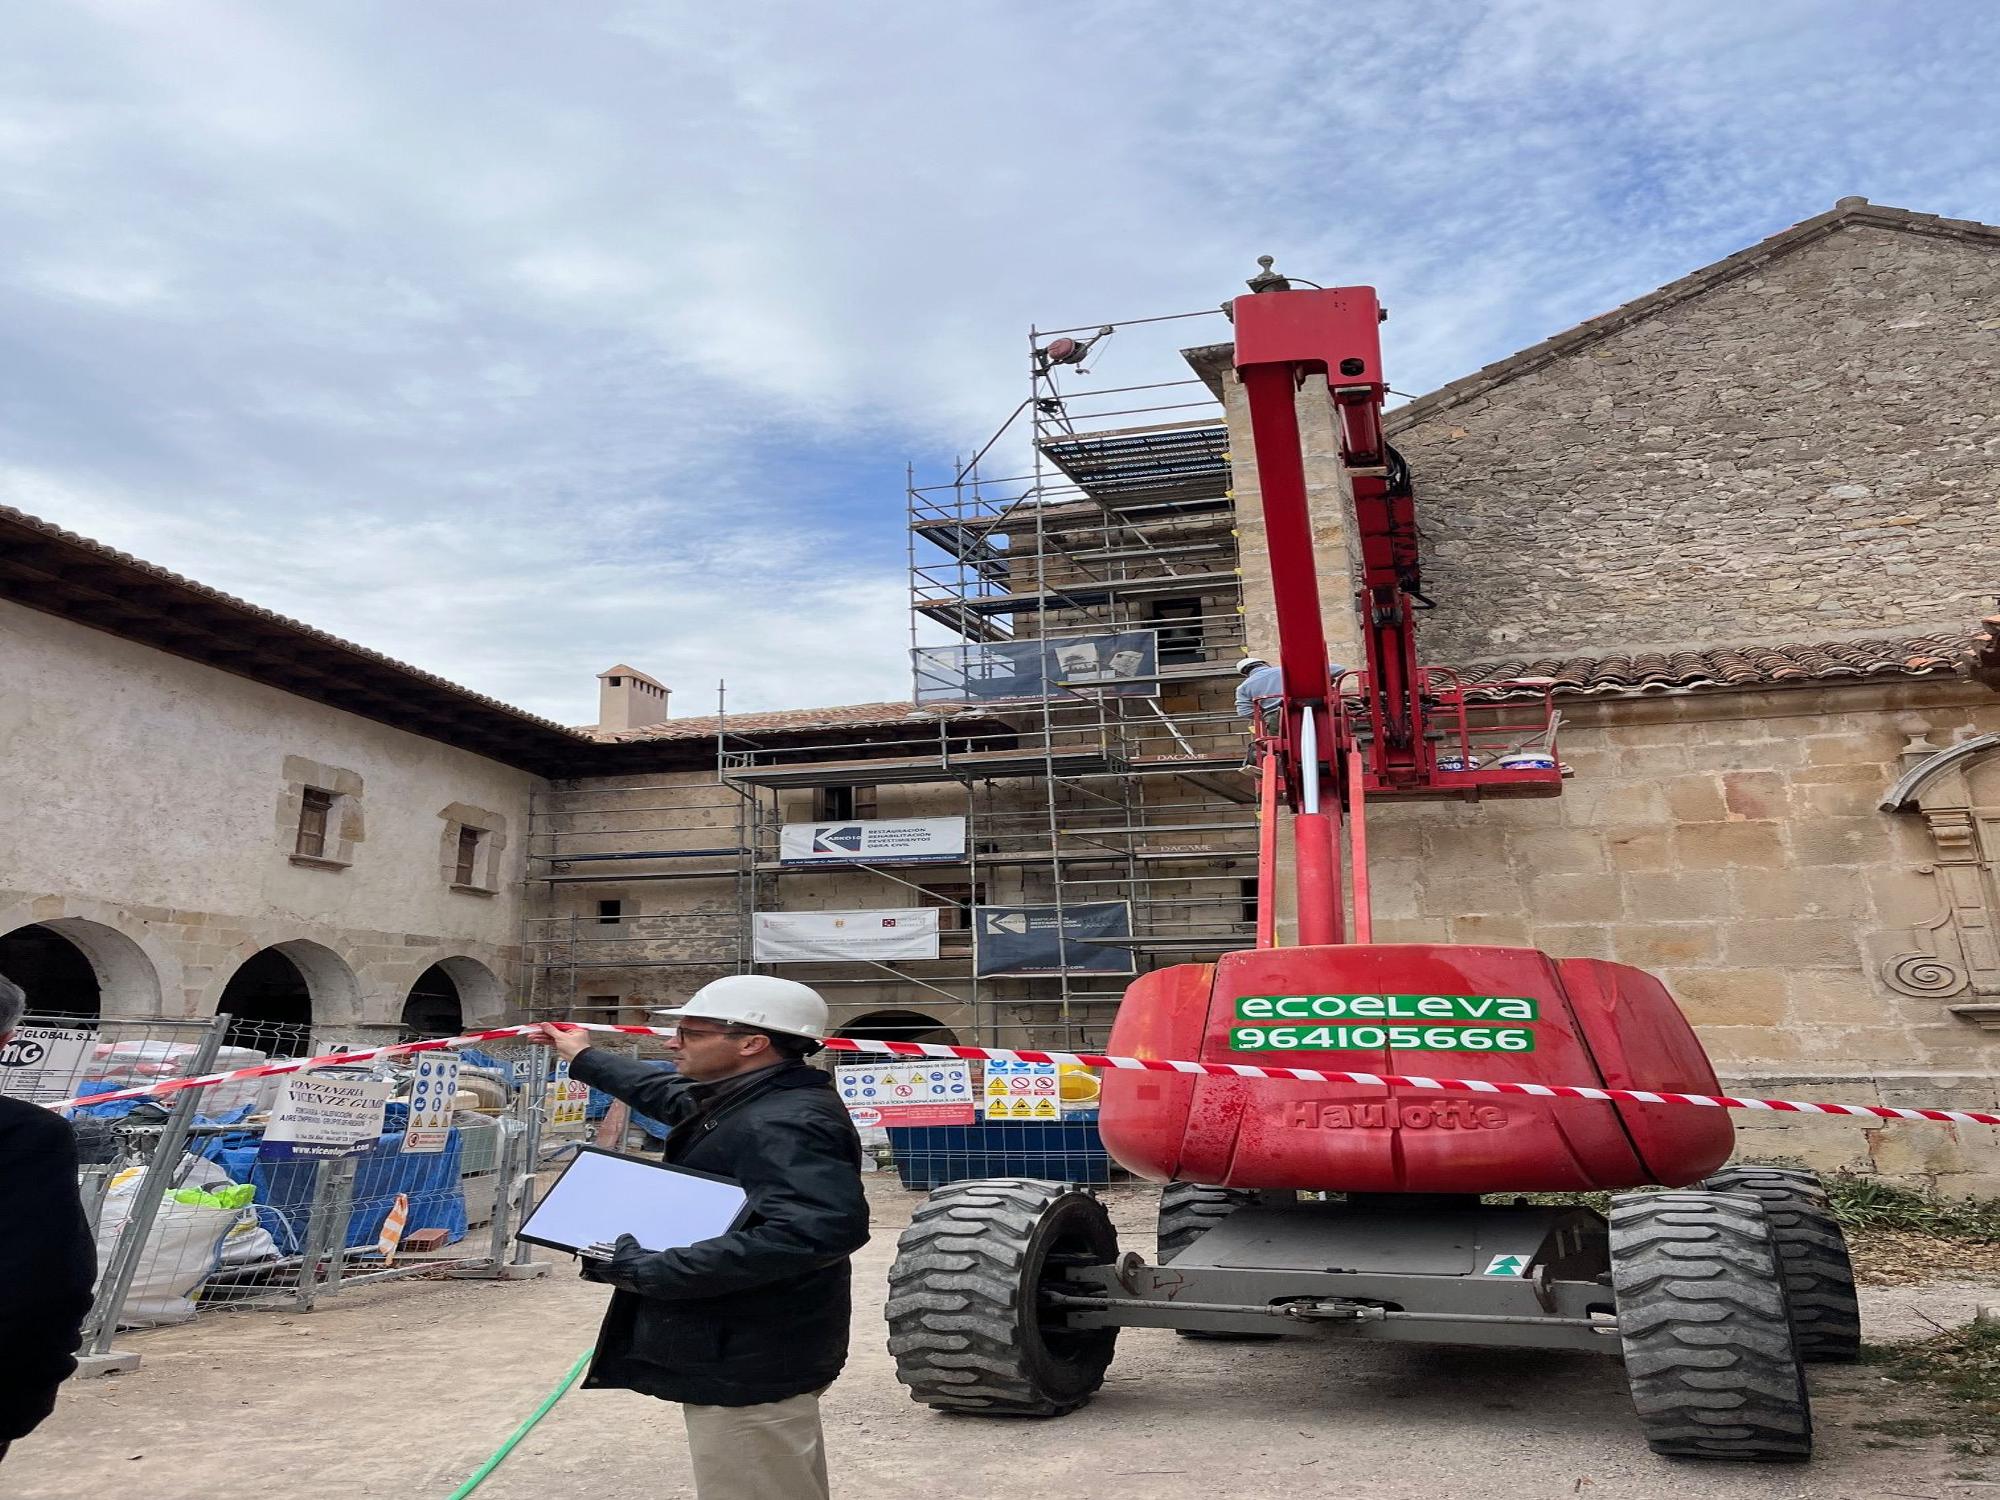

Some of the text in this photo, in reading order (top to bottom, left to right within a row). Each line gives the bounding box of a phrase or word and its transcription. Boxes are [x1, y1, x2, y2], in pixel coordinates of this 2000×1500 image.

[1157, 753, 1209, 761] DACAME
[1160, 844, 1213, 852] DACAME
[24, 1030, 73, 1042] GLOBAL,
[1236, 1027, 1528, 1050] 964105666
[288, 1091, 350, 1107] VICENTE
[1282, 1098, 1509, 1130] Haulotte
